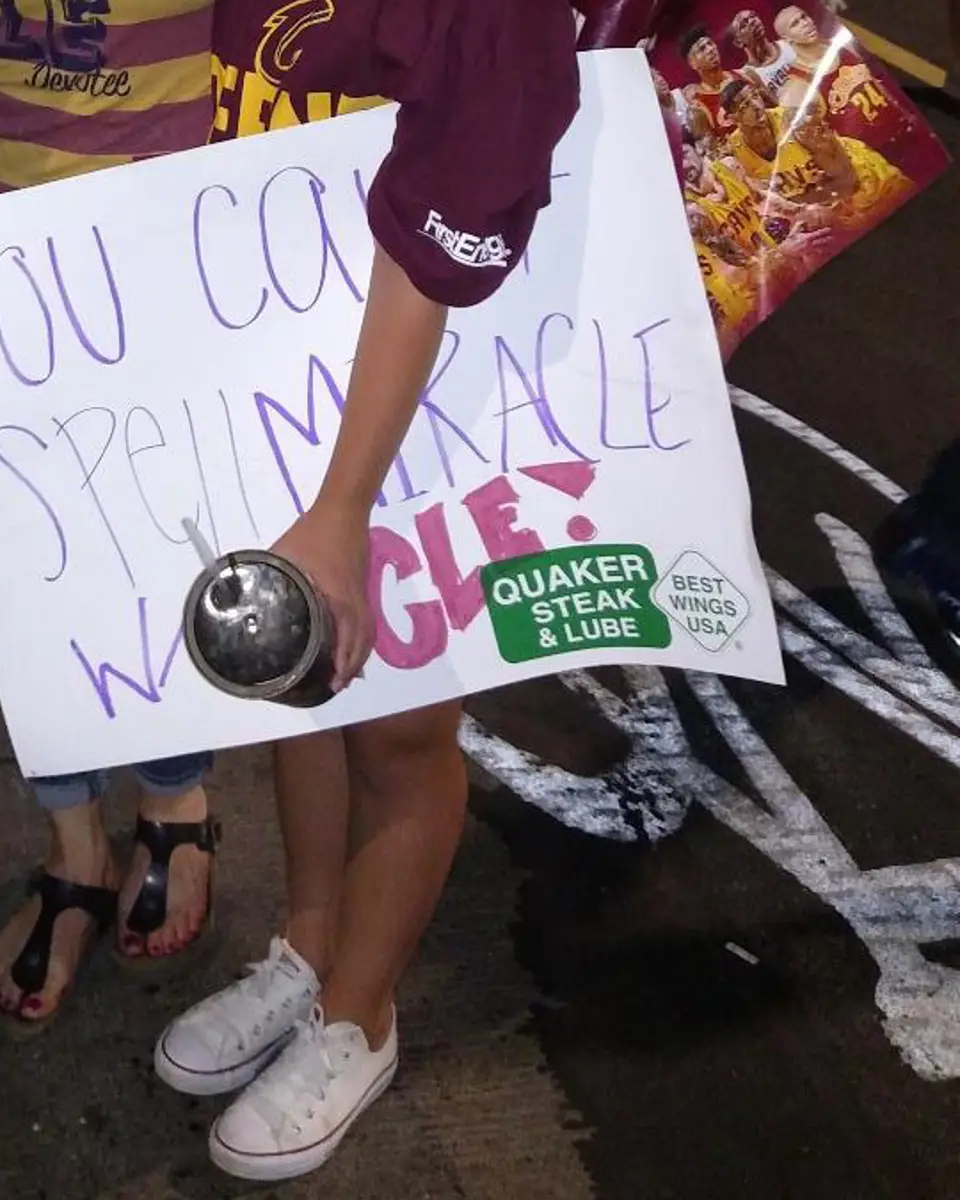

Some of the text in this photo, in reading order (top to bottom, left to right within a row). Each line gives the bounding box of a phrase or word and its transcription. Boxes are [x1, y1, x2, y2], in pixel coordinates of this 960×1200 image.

[491, 553, 649, 606] QUAKER
[672, 574, 725, 595] BEST
[531, 587, 642, 625] STEAK
[668, 593, 738, 617] WINGS
[539, 616, 641, 648] & LUBE
[686, 616, 729, 637] USA
